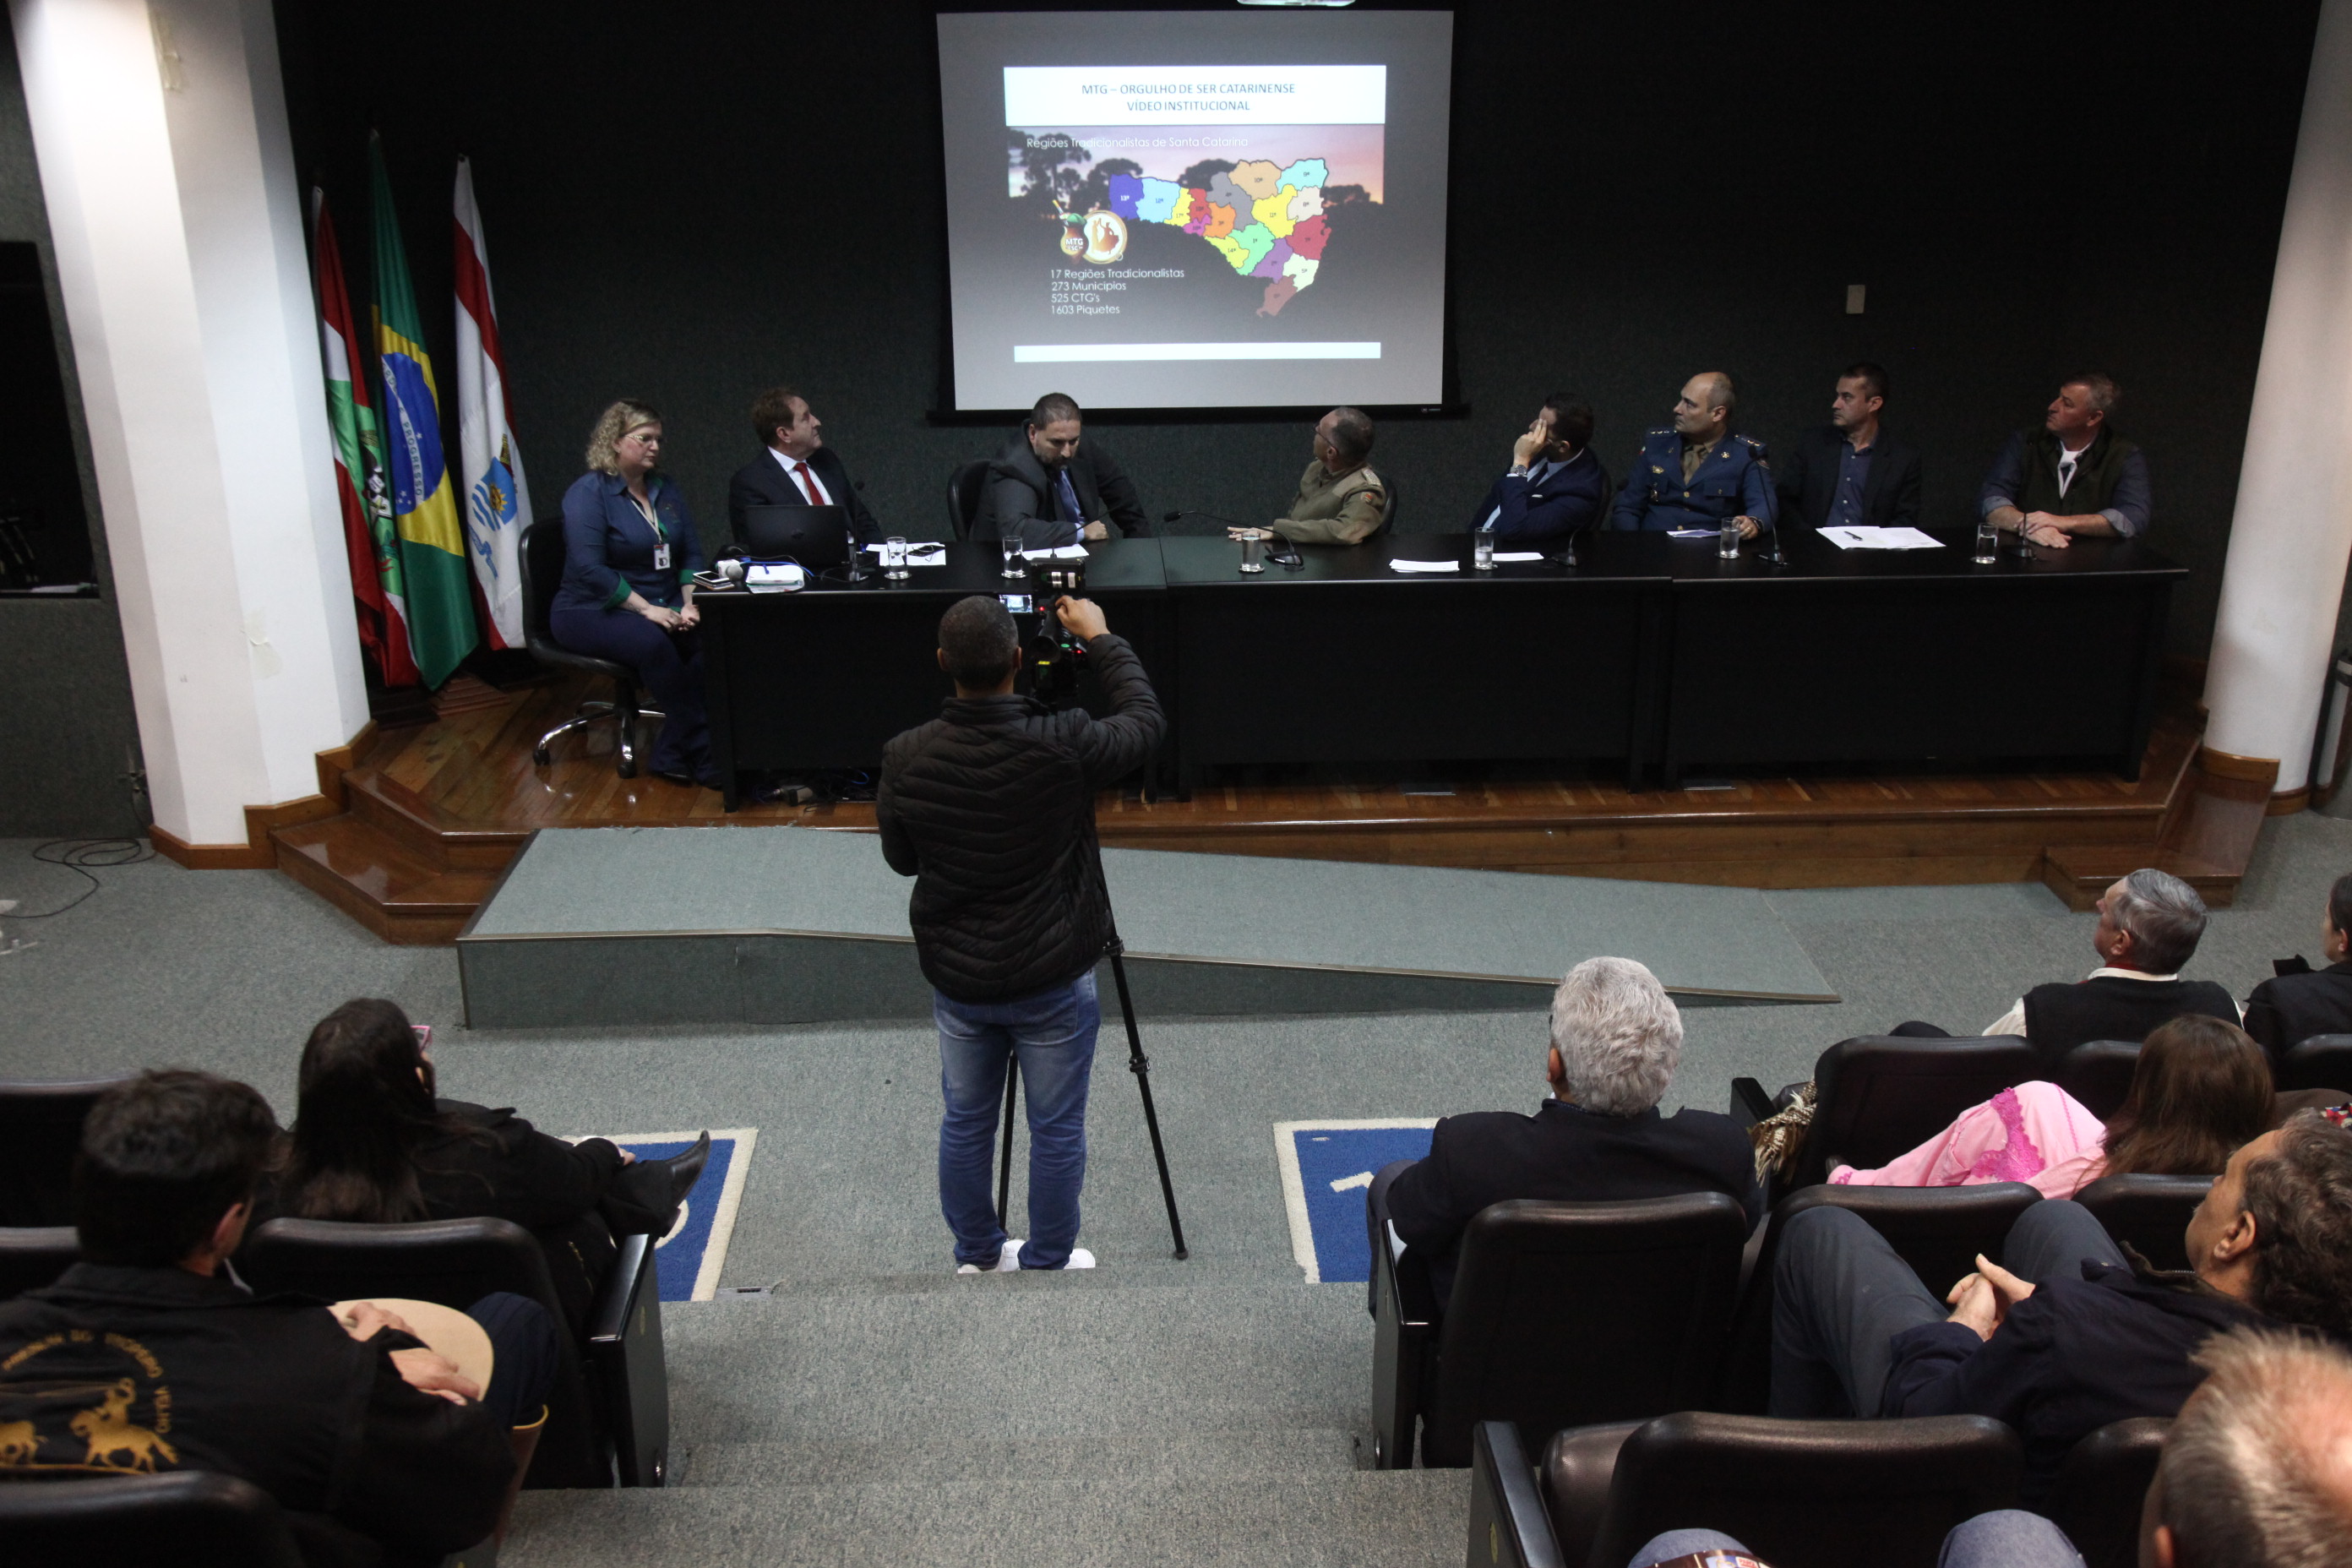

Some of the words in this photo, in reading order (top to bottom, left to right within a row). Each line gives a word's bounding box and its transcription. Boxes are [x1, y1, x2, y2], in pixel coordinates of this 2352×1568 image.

[1082, 84, 1108, 95] MTG
[1120, 84, 1177, 95] ORGULHO
[1179, 84, 1193, 94] DE
[1196, 84, 1217, 94] SER
[1219, 83, 1295, 94] CATARINENSE
[1127, 99, 1162, 111] VÍDEO
[1164, 101, 1250, 112] INSTITUCIONAL
[1026, 138, 1068, 150] Regiões
[1071, 137, 1150, 148] Tradicionalistas
[1152, 138, 1166, 147] de
[1168, 137, 1200, 147] Santa
[1202, 137, 1248, 147] Catarina
[1065, 237, 1084, 246] MTG
[1050, 269, 1061, 279] 17
[1064, 269, 1105, 280] Regiões
[1108, 269, 1184, 278] Tradicionalistas
[1052, 281, 1070, 291] 273
[1051, 293, 1069, 302] 525
[1071, 293, 1100, 302] CTG's
[1051, 305, 1074, 314] 1603
[1076, 305, 1120, 316] Piquetes
[403, 422, 422, 496] PROGRESSO
